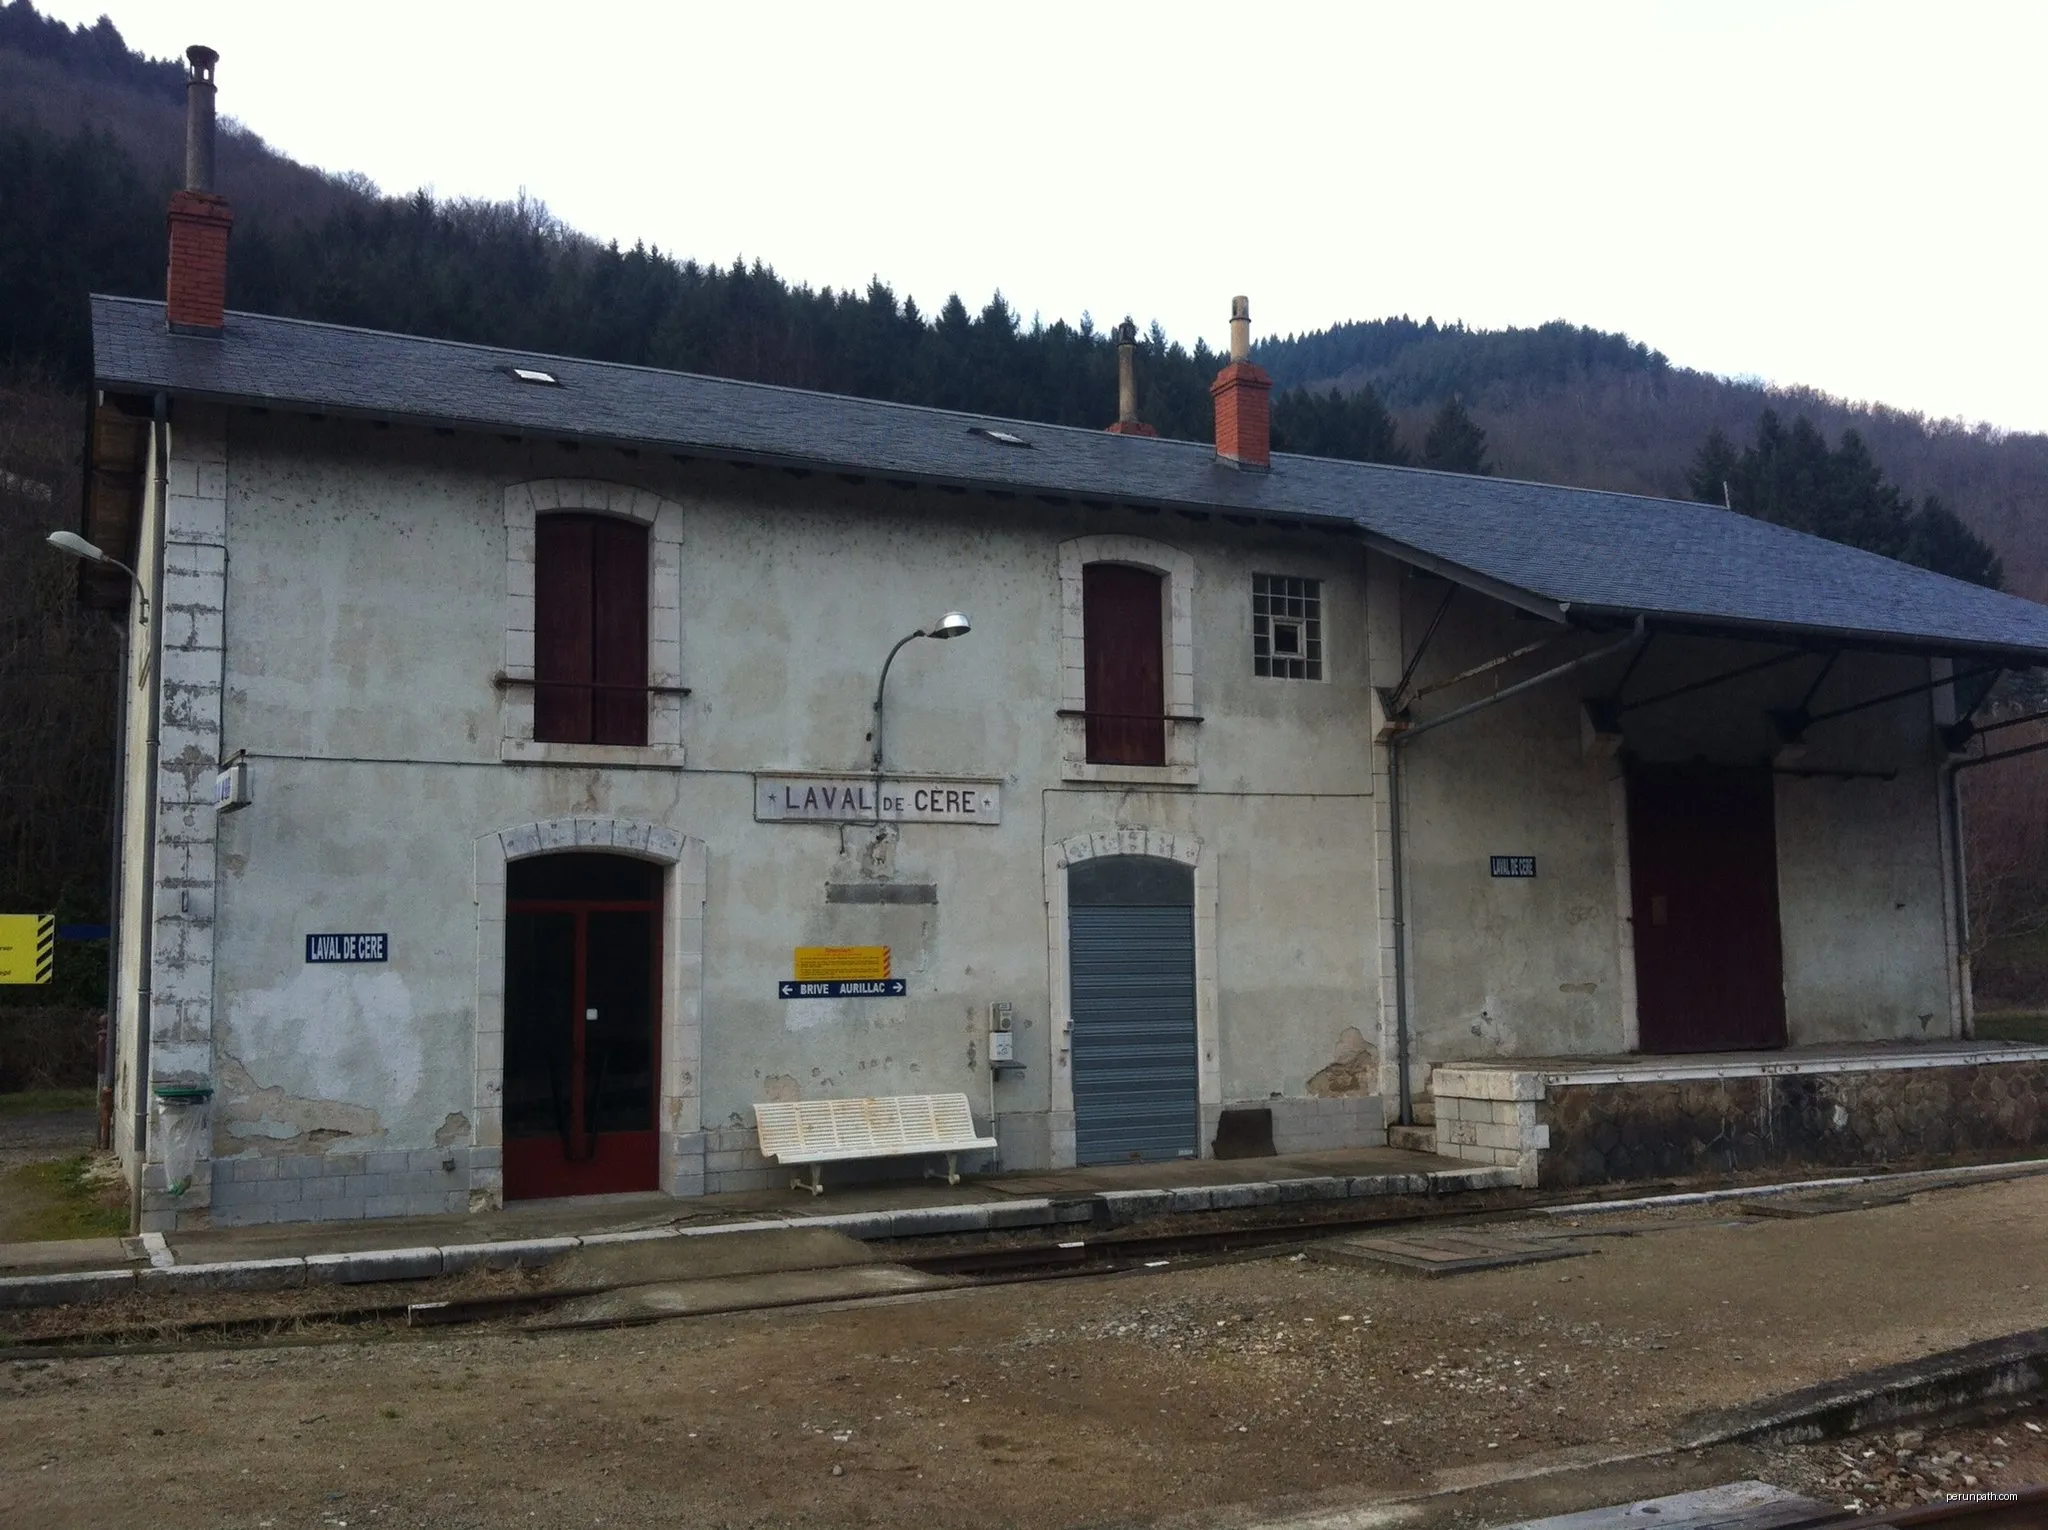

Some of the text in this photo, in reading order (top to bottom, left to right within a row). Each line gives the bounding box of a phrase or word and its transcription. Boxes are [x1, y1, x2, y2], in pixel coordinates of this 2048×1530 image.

[785, 786, 873, 810] LAVAL
[1492, 857, 1511, 875] LAVAL
[1511, 858, 1519, 875] DE
[311, 936, 383, 960] LAVAL DE CERE
[800, 982, 886, 995] BRIVE AURILLAC
